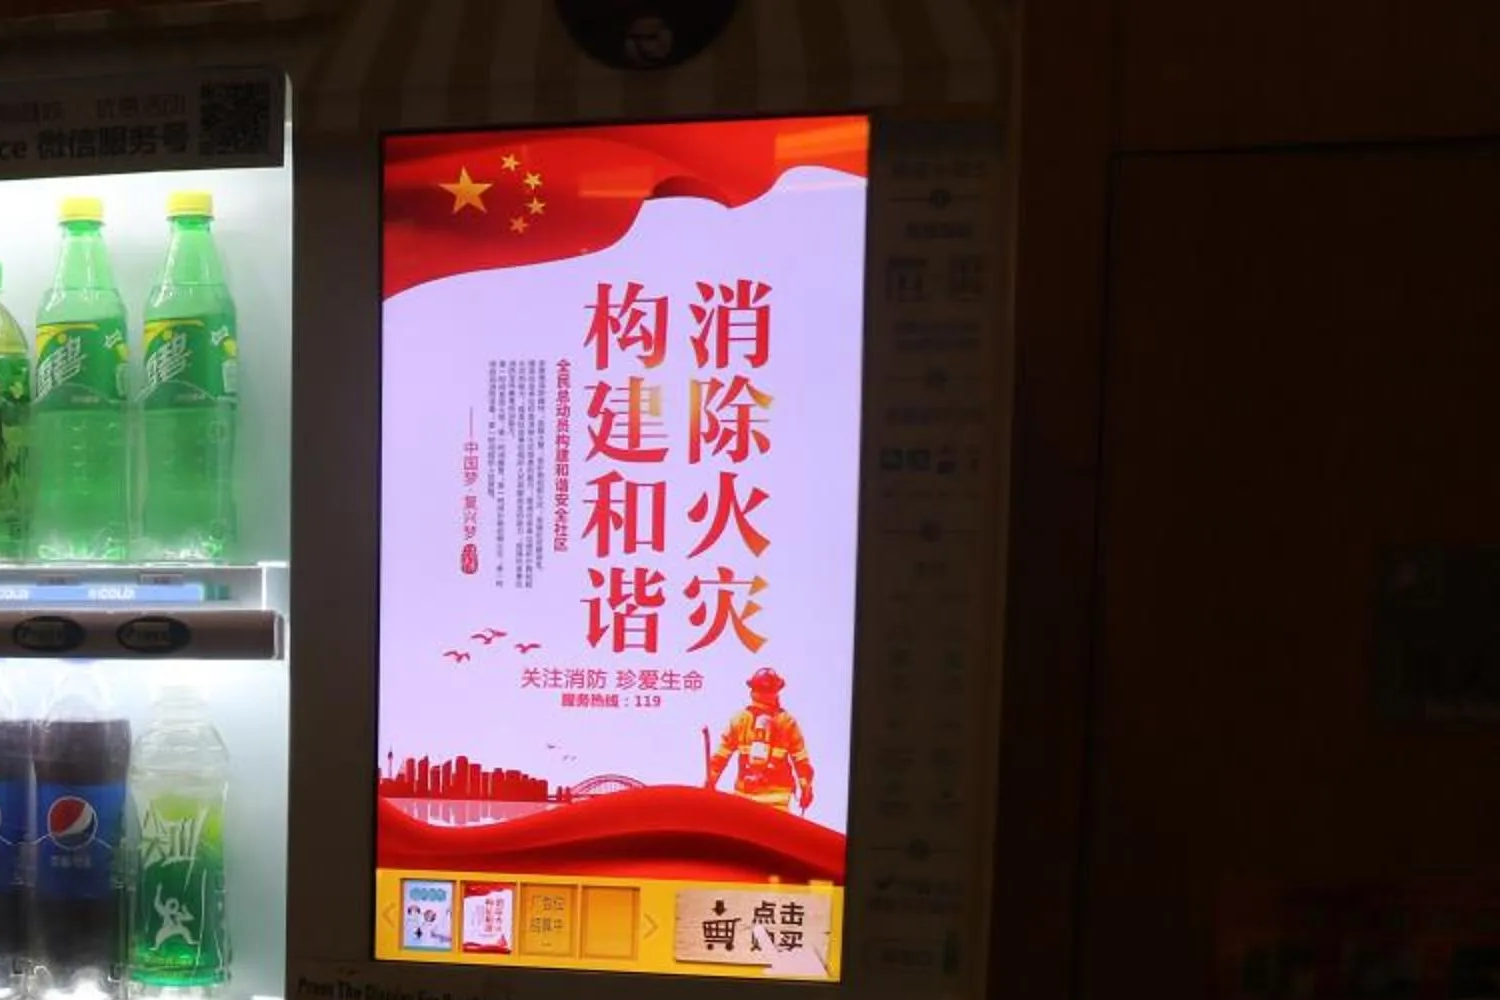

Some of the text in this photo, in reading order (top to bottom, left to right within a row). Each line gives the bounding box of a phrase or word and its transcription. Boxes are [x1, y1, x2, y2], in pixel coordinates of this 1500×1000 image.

[580, 281, 670, 654] 构建和谐
[687, 279, 774, 654] 消除火灾
[521, 667, 705, 691] 关注消防 珍爱生命
[752, 900, 804, 926] 点击
